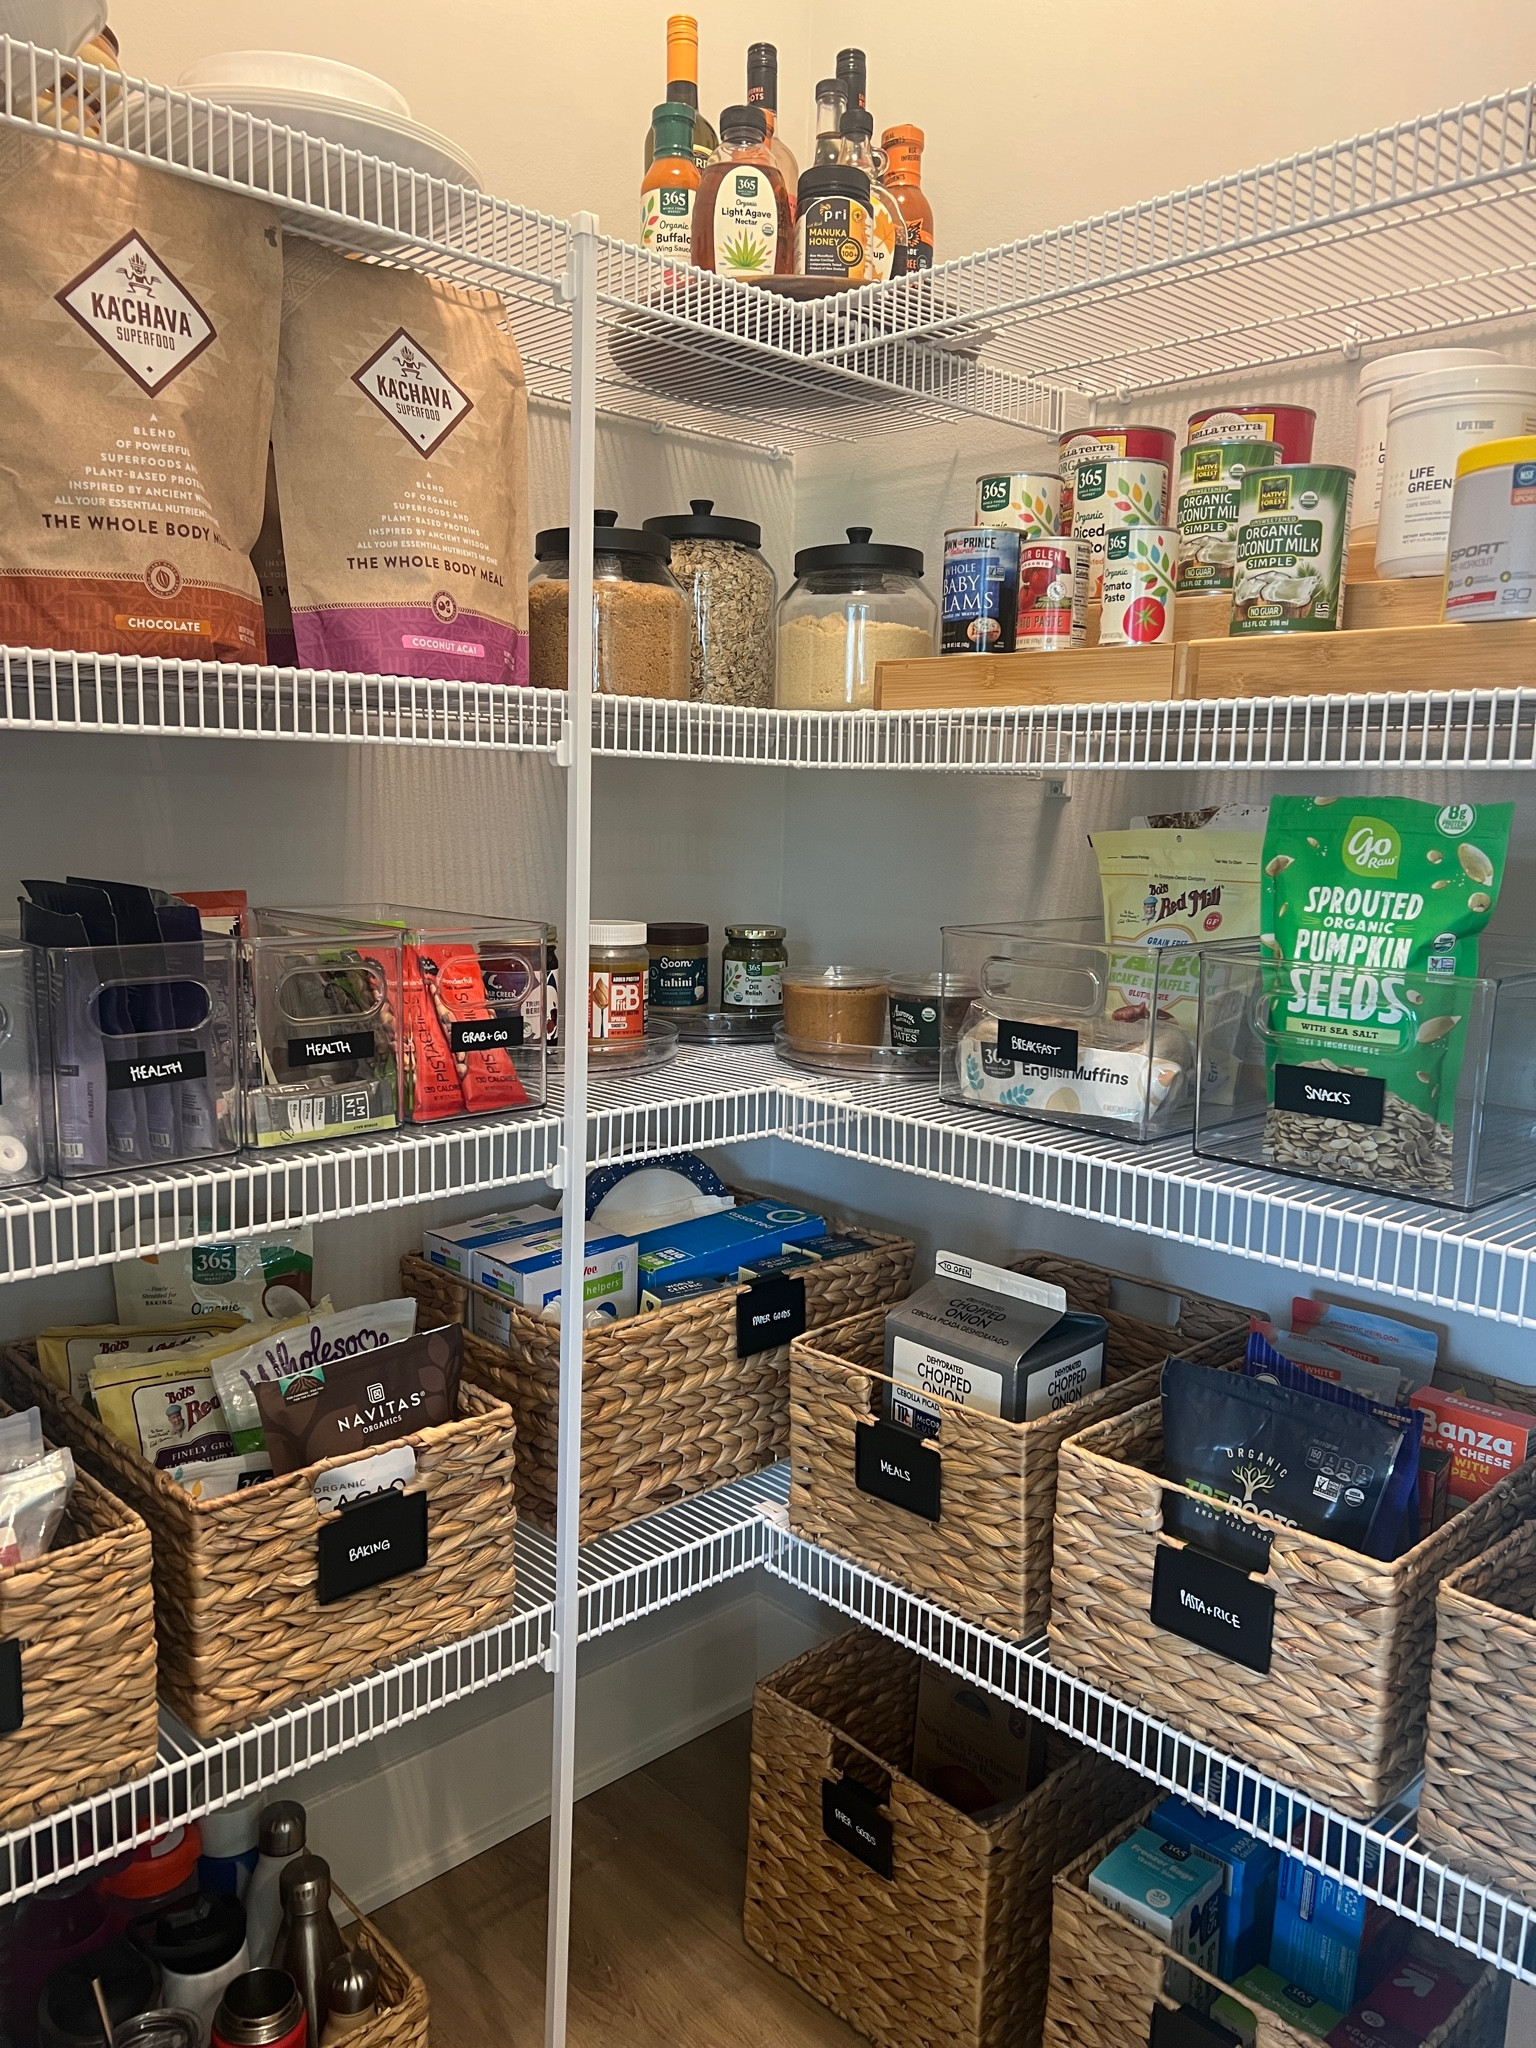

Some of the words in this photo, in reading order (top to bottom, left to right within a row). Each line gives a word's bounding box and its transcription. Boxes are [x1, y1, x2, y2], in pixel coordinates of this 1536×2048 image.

[737, 179, 756, 190] 365
[662, 191, 686, 206] 365
[721, 207, 743, 217] Light
[745, 208, 771, 219] Agave
[824, 209, 847, 223] pri
[659, 220, 689, 232] Organic
[735, 218, 757, 226] Nectar
[809, 229, 847, 237] MANUKA
[809, 238, 839, 246] HONEY
[117, 326, 175, 351] SUPERFOOD
[396, 402, 440, 421] SUPERFOOD
[133, 426, 176, 439] BLEND
[116, 439, 132, 448] OF
[135, 441, 191, 457] POWERFUL
[100, 452, 181, 469] SUPERFOODS
[85, 466, 167, 482] PLANT-BASED
[1079, 469, 1102, 488] 365
[1409, 466, 1435, 480] LIFE
[69, 480, 124, 493] INSPIRED
[128, 485, 142, 495] BY
[145, 488, 192, 501] ANCIENT
[416, 481, 444, 493] BLEND
[983, 481, 1006, 499] 365
[1262, 490, 1286, 499] NATIVE
[1408, 478, 1453, 494] GREEN
[55, 495, 74, 505] ALL
[75, 496, 106, 507] YOUR
[108, 498, 163, 512] ESSENTIAL
[404, 491, 416, 499] OF
[419, 494, 458, 508] ORGANIC
[1183, 493, 1232, 509] ORGANIC
[1261, 497, 1286, 506] FOREST
[393, 502, 451, 518] SUPERFOODS
[1075, 511, 1104, 525] Organic
[42, 513, 81, 530] THE
[88, 515, 159, 535] WHOLE
[166, 522, 210, 541] BODY
[381, 514, 441, 528] PLANT-BASED
[444, 521, 480, 537] PROTEINS
[1074, 524, 1105, 539] Diced
[1184, 523, 1224, 534] SIMPLE
[1246, 524, 1303, 540] ORGANIC
[368, 528, 413, 536] INSPIRED
[428, 531, 461, 543] ANCIENT
[1108, 536, 1127, 549] 365
[401, 540, 442, 552] ESSENTIAL
[442, 544, 478, 560] NUTRIENTS
[1286, 538, 1319, 553] MILK
[1450, 542, 1505, 562] SPORT
[1035, 550, 1060, 560] GLEN
[1248, 557, 1293, 568] SIMPLE
[347, 556, 378, 570] THE
[383, 555, 440, 570] WHOLE
[444, 560, 477, 578] BODY
[480, 568, 505, 588] MEAL
[1105, 568, 1128, 578] Organic
[943, 575, 980, 596] BABY
[1103, 581, 1131, 592] Tomato
[1502, 588, 1532, 600] 30
[942, 592, 993, 614] LAMS
[1104, 593, 1125, 603] Paste
[1250, 608, 1260, 616] NO
[1261, 606, 1280, 616] GUAR
[128, 617, 200, 632] CHOCOLATE
[1035, 615, 1062, 627] PASTE
[412, 638, 456, 652] COCONUT
[456, 644, 477, 655] ACAI
[1368, 856, 1395, 869] Raw
[1156, 892, 1187, 923] Red
[1188, 885, 1222, 918] Mill
[1303, 886, 1424, 921] SPROUTED
[1206, 918, 1219, 926] GF
[1323, 916, 1395, 934] ORGANIC
[1293, 929, 1413, 969] PUMPKIN
[660, 957, 692, 969] Soom
[660, 977, 692, 988] tahini
[611, 985, 640, 1011] PB
[1287, 968, 1406, 1024] SEEDS
[617, 1000, 628, 1010] fit
[893, 1029, 918, 1043] DATES
[1300, 1023, 1326, 1033] WITH
[1329, 1026, 1348, 1036] SEA
[1352, 1029, 1379, 1039] SALT
[305, 1041, 351, 1057] HEALTH
[1011, 1035, 1062, 1056] BREAKFAST
[130, 1061, 183, 1082] HEALTH
[1072, 1064, 1129, 1087] Muffins
[1304, 1085, 1351, 1105] SNACKS
[728, 1210, 776, 1230] assorted
[197, 1251, 232, 1272] 365
[943, 1263, 952, 1271] TO
[953, 1265, 971, 1277] OPEN
[586, 1281, 620, 1298] helpers
[665, 1280, 694, 1288] WORLD
[667, 1282, 703, 1293] CENTRIC
[752, 1313, 771, 1326] PAPER
[773, 1309, 791, 1321] GOODS
[911, 1308, 938, 1322] CEBOLLA
[938, 1316, 960, 1331] PICADA
[945, 1308, 993, 1330] ONION
[950, 1299, 1007, 1323] CHOPPED
[1364, 1330, 1400, 1343] HEIRLOOM
[99, 1340, 130, 1355] Bob's
[927, 1355, 964, 1375] DEHYDRATED
[1054, 1360, 1082, 1377] DEHYDRATED
[1305, 1366, 1334, 1379] WHITE
[917, 1363, 972, 1394] CHOPPED
[1047, 1368, 1087, 1397] CHOPPED
[165, 1385, 195, 1405] Bob's
[896, 1387, 921, 1404] CEBOLLA
[338, 1392, 421, 1433] NAVITAS
[1444, 1396, 1503, 1417] Banza
[362, 1415, 402, 1434] ORGANICS
[1373, 1408, 1412, 1424] AMERICAN
[1418, 1406, 1513, 1457] Banza
[172, 1445, 206, 1461] FINELY
[1447, 1443, 1455, 1452] &
[1459, 1447, 1512, 1470] CHEESE
[880, 1459, 911, 1483] MEALS
[1227, 1448, 1288, 1479] ORGANIC
[1454, 1456, 1490, 1475] WITH
[314, 1478, 366, 1494] ORGANIC
[1195, 1507, 1221, 1522] KNOW
[1225, 1519, 1247, 1533] YOUR
[349, 1540, 390, 1562] BAKING
[1131, 1843, 1170, 1868] Freezer
[1165, 1843, 1189, 1858] 365
[1231, 1837, 1252, 1857] PARA
[1207, 1895, 1219, 1934] 365
